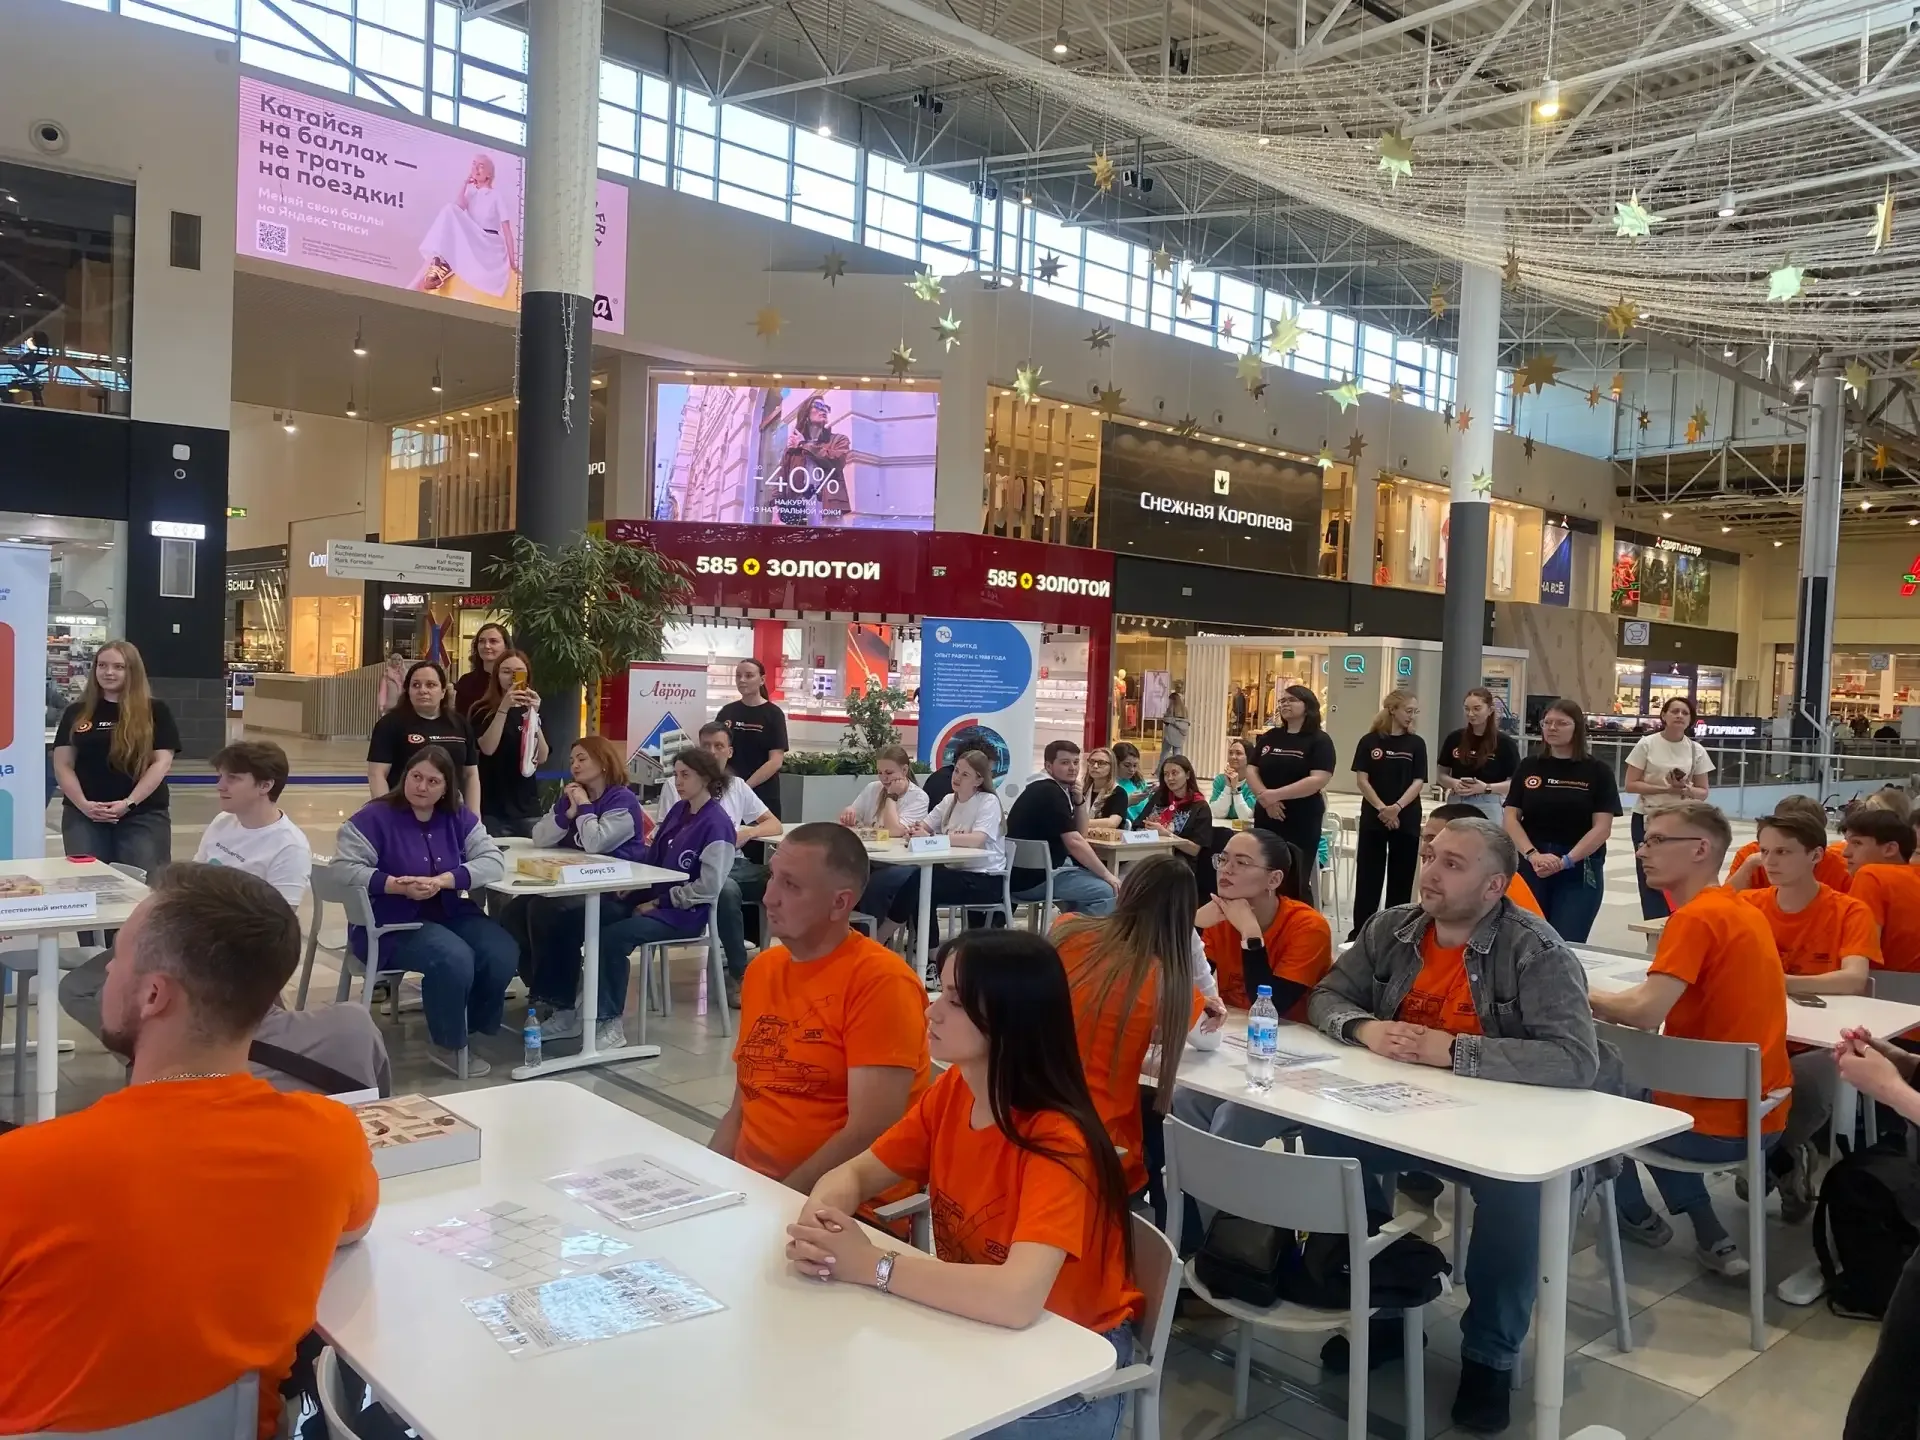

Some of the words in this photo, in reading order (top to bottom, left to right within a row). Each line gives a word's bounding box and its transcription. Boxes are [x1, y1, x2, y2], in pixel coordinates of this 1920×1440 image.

[260, 94, 363, 139] Катайся
[260, 120, 290, 139] на
[298, 126, 388, 166] баллах
[259, 140, 289, 159] не
[296, 149, 366, 179] трать
[259, 161, 290, 180] на
[297, 170, 404, 208] поездки!
[258, 187, 304, 208] Меняй
[307, 201, 338, 216] свои
[341, 208, 384, 227] баллы
[258, 203, 275, 214] на
[278, 206, 329, 227] Яндекс
[331, 219, 369, 236] такси
[753, 466, 840, 494] -40%
[696, 556, 738, 575] 585
[766, 559, 880, 580] ЗОЛОТОЙ
[228, 579, 255, 591] SCHULZ
[988, 569, 1017, 588] 585
[1036, 574, 1111, 598] ЗОЛОТОЙ
[640, 680, 697, 700] Аврора
[580, 866, 606, 875] Сириус
[0, 904, 49, 914] стественный
[50, 903, 88, 911] интеллект
